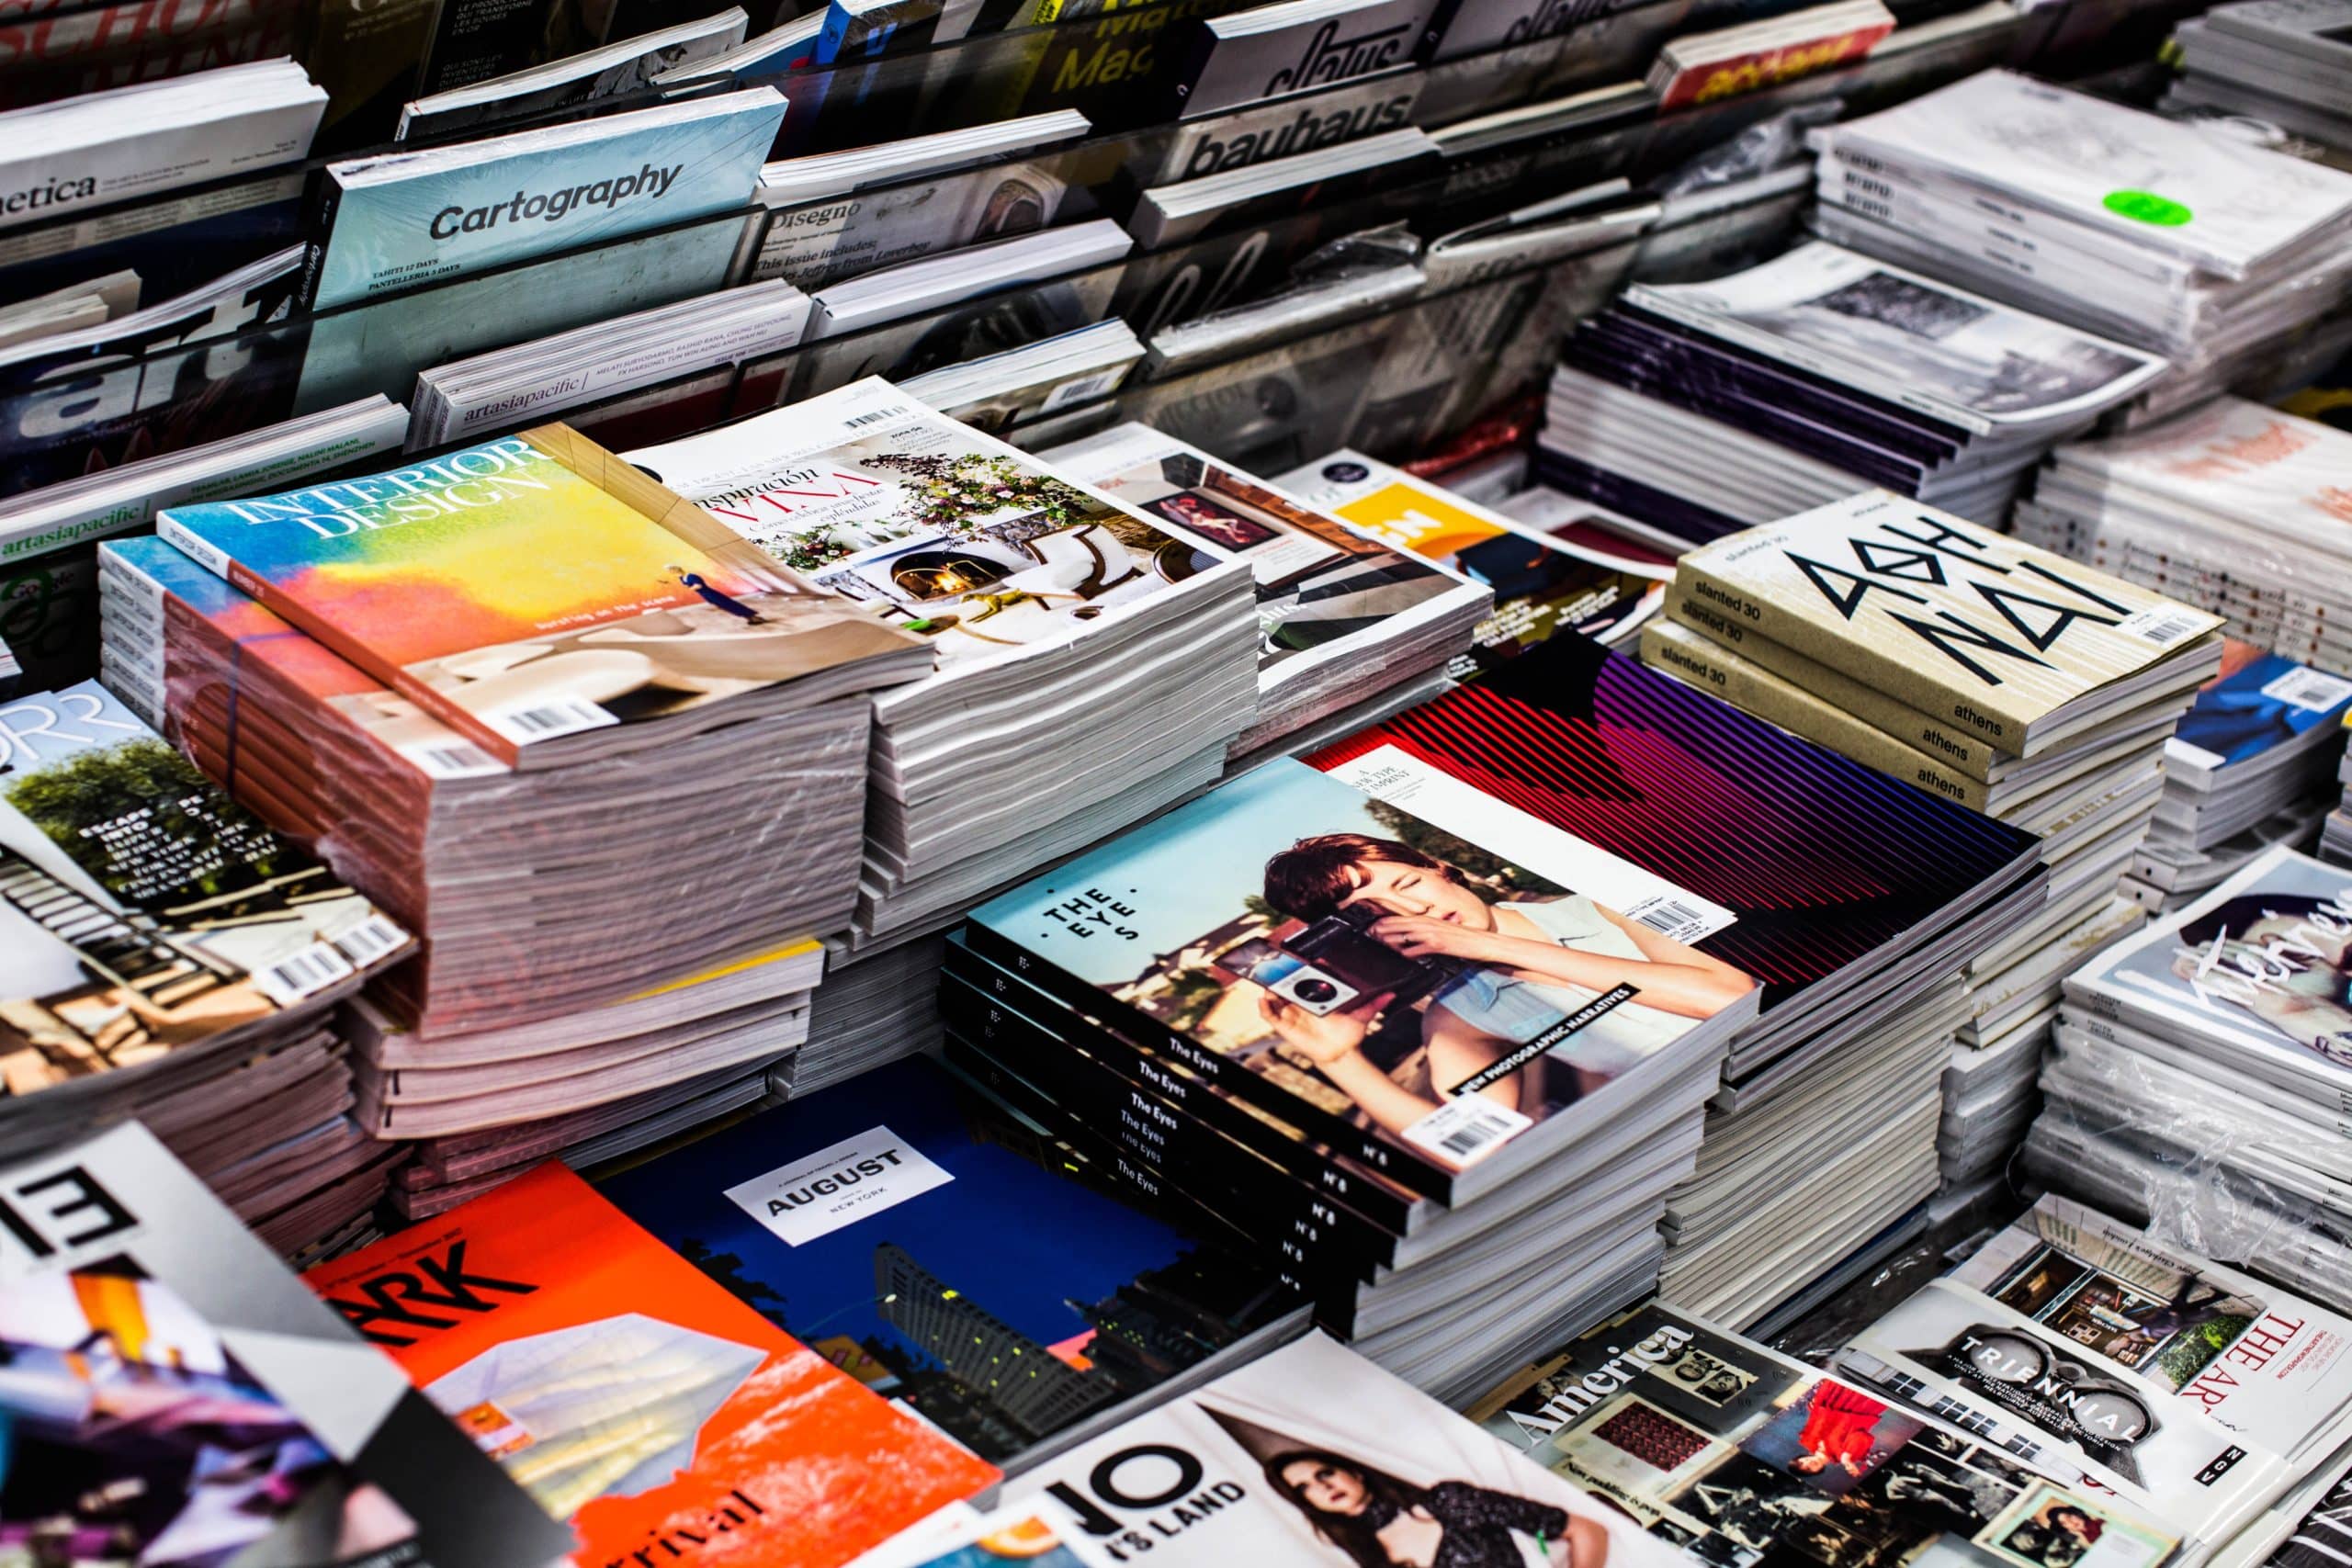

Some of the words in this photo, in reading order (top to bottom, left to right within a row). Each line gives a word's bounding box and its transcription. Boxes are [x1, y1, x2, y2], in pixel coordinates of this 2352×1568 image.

[1183, 95, 1414, 175] bauhaus
[429, 164, 684, 241] Cartography
[463, 375, 581, 424] artasiapacific
[224, 437, 558, 526] INTERIOR
[692, 467, 821, 513] nspiración
[295, 467, 552, 541] DESIGN
[2, 507, 141, 555] artasiapacific
[1679, 601, 1725, 636] slanted
[1723, 624, 1743, 643] 30
[1694, 579, 1744, 614] slanted
[1742, 602, 1761, 622] 30
[1660, 646, 1708, 680] slanted
[1707, 667, 1726, 687] 30
[1953, 702, 2004, 737] athens
[1922, 726, 1969, 761] athens
[1917, 767, 1966, 800] athens
[78, 807, 153, 838] ESCAPE
[1042, 887, 1113, 922] THE
[1170, 1036, 1191, 1059] The
[1193, 1049, 1220, 1075] Eyes
[1485, 1024, 1569, 1080] PHOTOGRAPHIC
[1566, 987, 1632, 1030] NARRATIVES
[1138, 1060, 1160, 1084] The
[1160, 1073, 1187, 1099] Eyes
[1120, 1109, 1140, 1130] The
[1140, 1122, 1166, 1146] Eyes
[1131, 1091, 1152, 1114] The
[1152, 1104, 1179, 1130] Eyes
[766, 1148, 902, 1218] AUGUST
[1116, 1157, 1136, 1179] The
[1136, 1171, 1159, 1196] Eyes
[830, 1201, 855, 1214] NEW
[855, 1185, 888, 1203] YORK
[325, 1238, 540, 1348] ARK
[2224, 1312, 2306, 1372] THE
[1504, 1324, 1696, 1455] America
[1960, 1336, 2140, 1444] TRIENNIAL
[2179, 1364, 2241, 1415] AR
[2200, 1448, 2243, 1483] NGV
[1148, 1480, 1248, 1539] LAND
